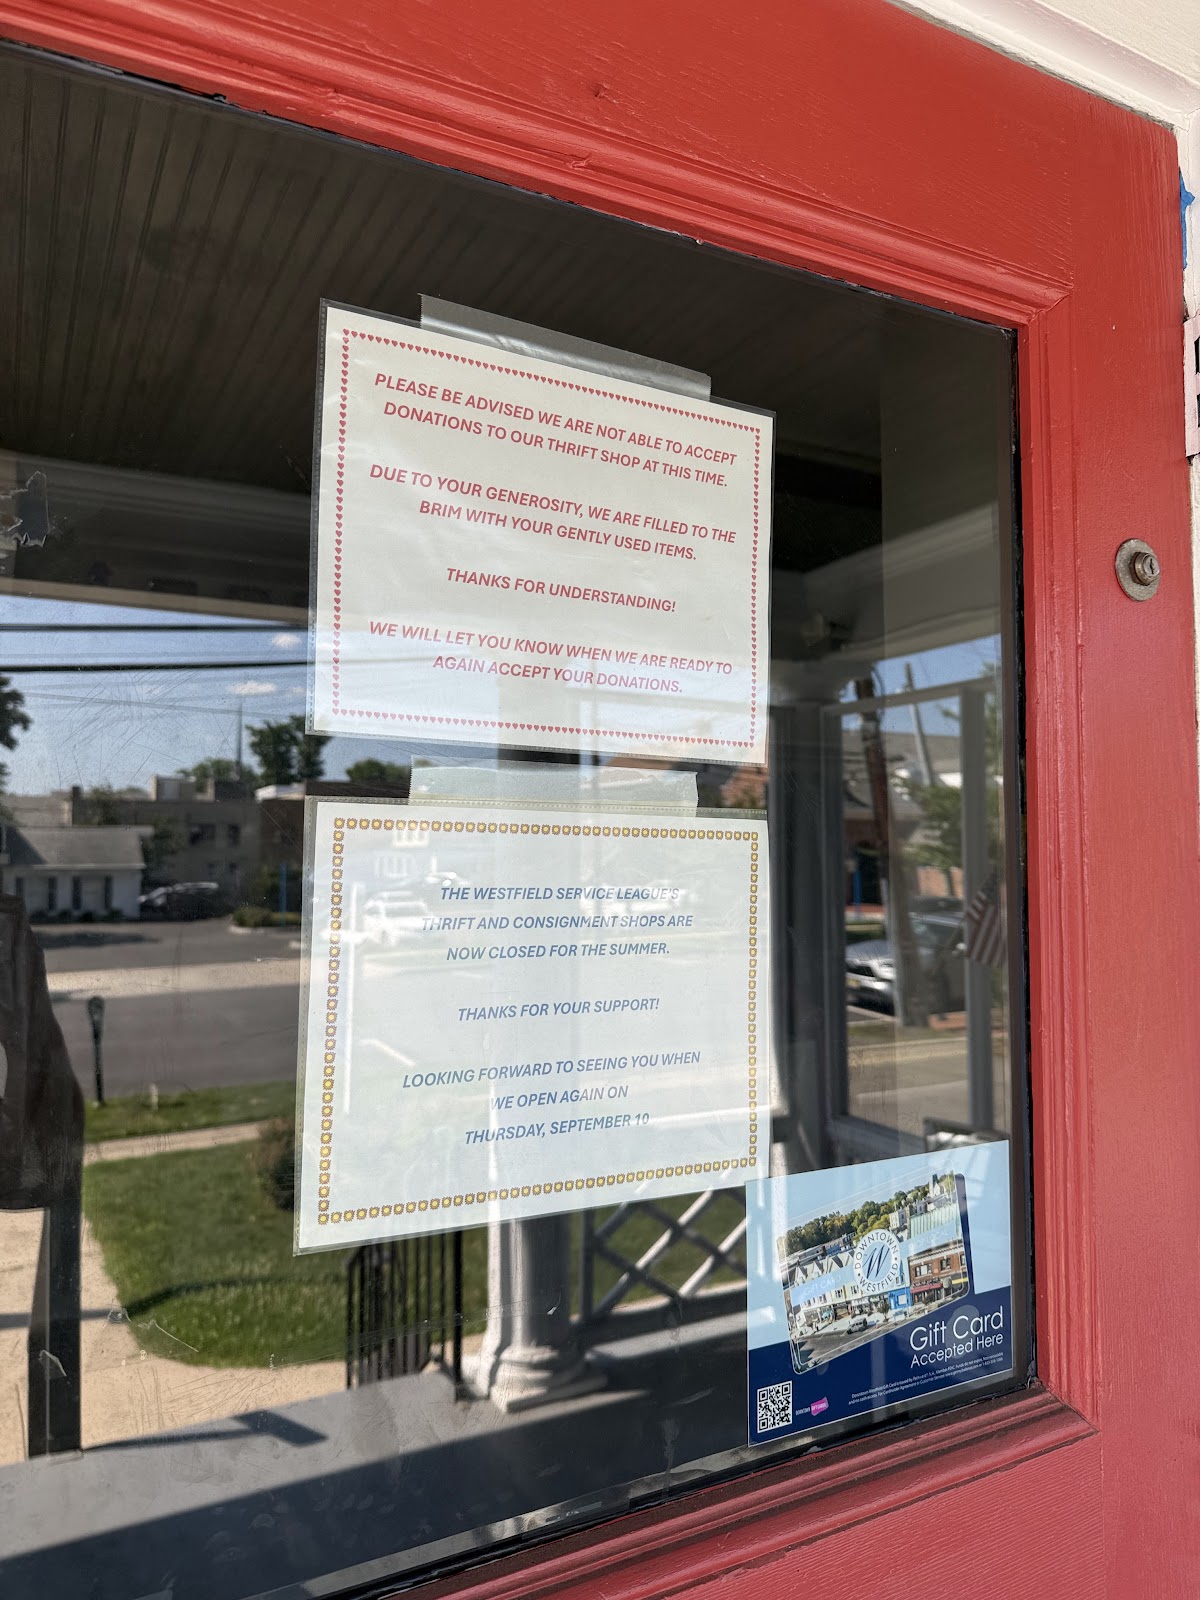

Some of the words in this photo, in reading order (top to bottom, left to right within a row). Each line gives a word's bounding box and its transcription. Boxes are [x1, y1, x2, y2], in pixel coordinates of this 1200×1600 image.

[374, 373, 439, 399] PLEASE
[441, 388, 462, 405] BE
[464, 393, 535, 420] ADVISED
[538, 410, 562, 426] WE
[563, 415, 593, 433] ARE
[595, 423, 625, 440] NOT
[626, 429, 662, 448] ABLE
[664, 438, 683, 452] TO
[684, 442, 737, 464] ACCEPT
[384, 403, 483, 435] DONATIONS
[487, 425, 507, 440] TO
[510, 429, 544, 448] OUR
[546, 437, 598, 459] THRIFT
[600, 448, 641, 467] SHOP
[642, 457, 660, 471] AT
[661, 461, 692, 478] THIS
[695, 468, 728, 485] TIME.
[370, 466, 407, 484] DUE
[410, 473, 433, 489] TO
[436, 477, 483, 497] YOUR
[485, 486, 584, 517] GENEROSITY,
[587, 504, 611, 520] WE
[612, 509, 641, 525] ARE
[642, 514, 689, 533] FILLED
[691, 523, 709, 537] TO
[710, 526, 738, 542] THE
[419, 501, 462, 520] BRIM
[465, 509, 508, 528] WITH
[510, 517, 554, 535] YOUR
[555, 524, 613, 545] GENTLY
[613, 534, 652, 551] USED
[653, 541, 697, 559] ITEMS.
[446, 569, 511, 590] THANKS
[513, 578, 546, 595] FOR
[548, 583, 676, 612] UNDERSTANDING!
[369, 621, 398, 637] WE
[400, 625, 442, 642] WILL
[445, 630, 474, 645] LET
[476, 633, 511, 649] YOU
[514, 638, 563, 655] KNOW
[566, 644, 612, 660] WHEN
[614, 649, 637, 663] WE
[637, 652, 666, 666] ARE
[669, 655, 712, 671] READY
[714, 660, 733, 673] TO
[432, 657, 486, 674] AGAIN
[486, 662, 551, 680] ACCEPT
[552, 668, 594, 684] YOUR
[596, 673, 683, 692] DONATIONS.
[440, 887, 470, 900] THE
[473, 887, 553, 900] WESTFIELD
[556, 887, 614, 900] SERVICE
[422, 917, 474, 930] THRIFT
[475, 916, 510, 929] AND
[512, 915, 619, 929] CONSIGNMENT
[620, 914, 667, 928] SHOPS
[667, 914, 693, 927] ARE
[446, 946, 486, 960] NOW
[488, 945, 547, 959] CLOSED
[548, 944, 578, 957] FOR
[581, 943, 607, 957] THE
[608, 942, 670, 956] SUMMER.
[458, 1005, 517, 1020] THANKS
[520, 1003, 549, 1017] FOR
[552, 1001, 591, 1015] YOUR
[593, 997, 660, 1013] SUPPORT!
[402, 1069, 475, 1087] LOOKING
[477, 1063, 553, 1081] FORWARD
[555, 1061, 574, 1075] TO
[576, 1057, 628, 1073] SEEING
[631, 1054, 660, 1069] YOU
[661, 1051, 701, 1067] WHEN
[489, 1095, 514, 1109] WE
[516, 1091, 558, 1107] OPEN
[559, 1088, 605, 1104] AGAIN
[607, 1086, 629, 1100] ON
[465, 1123, 546, 1143] THURSDAY,
[549, 1115, 632, 1135] SEPTEMBER
[634, 1113, 650, 1127] 10
[855, 1232, 898, 1269] DOWNTOWN
[862, 1245, 890, 1279] W
[859, 1263, 898, 1292] WESTFIELD
[910, 1321, 947, 1351] Gift
[953, 1305, 1003, 1339] Card
[910, 1338, 973, 1368] Accepted
[976, 1333, 1003, 1350] Here
